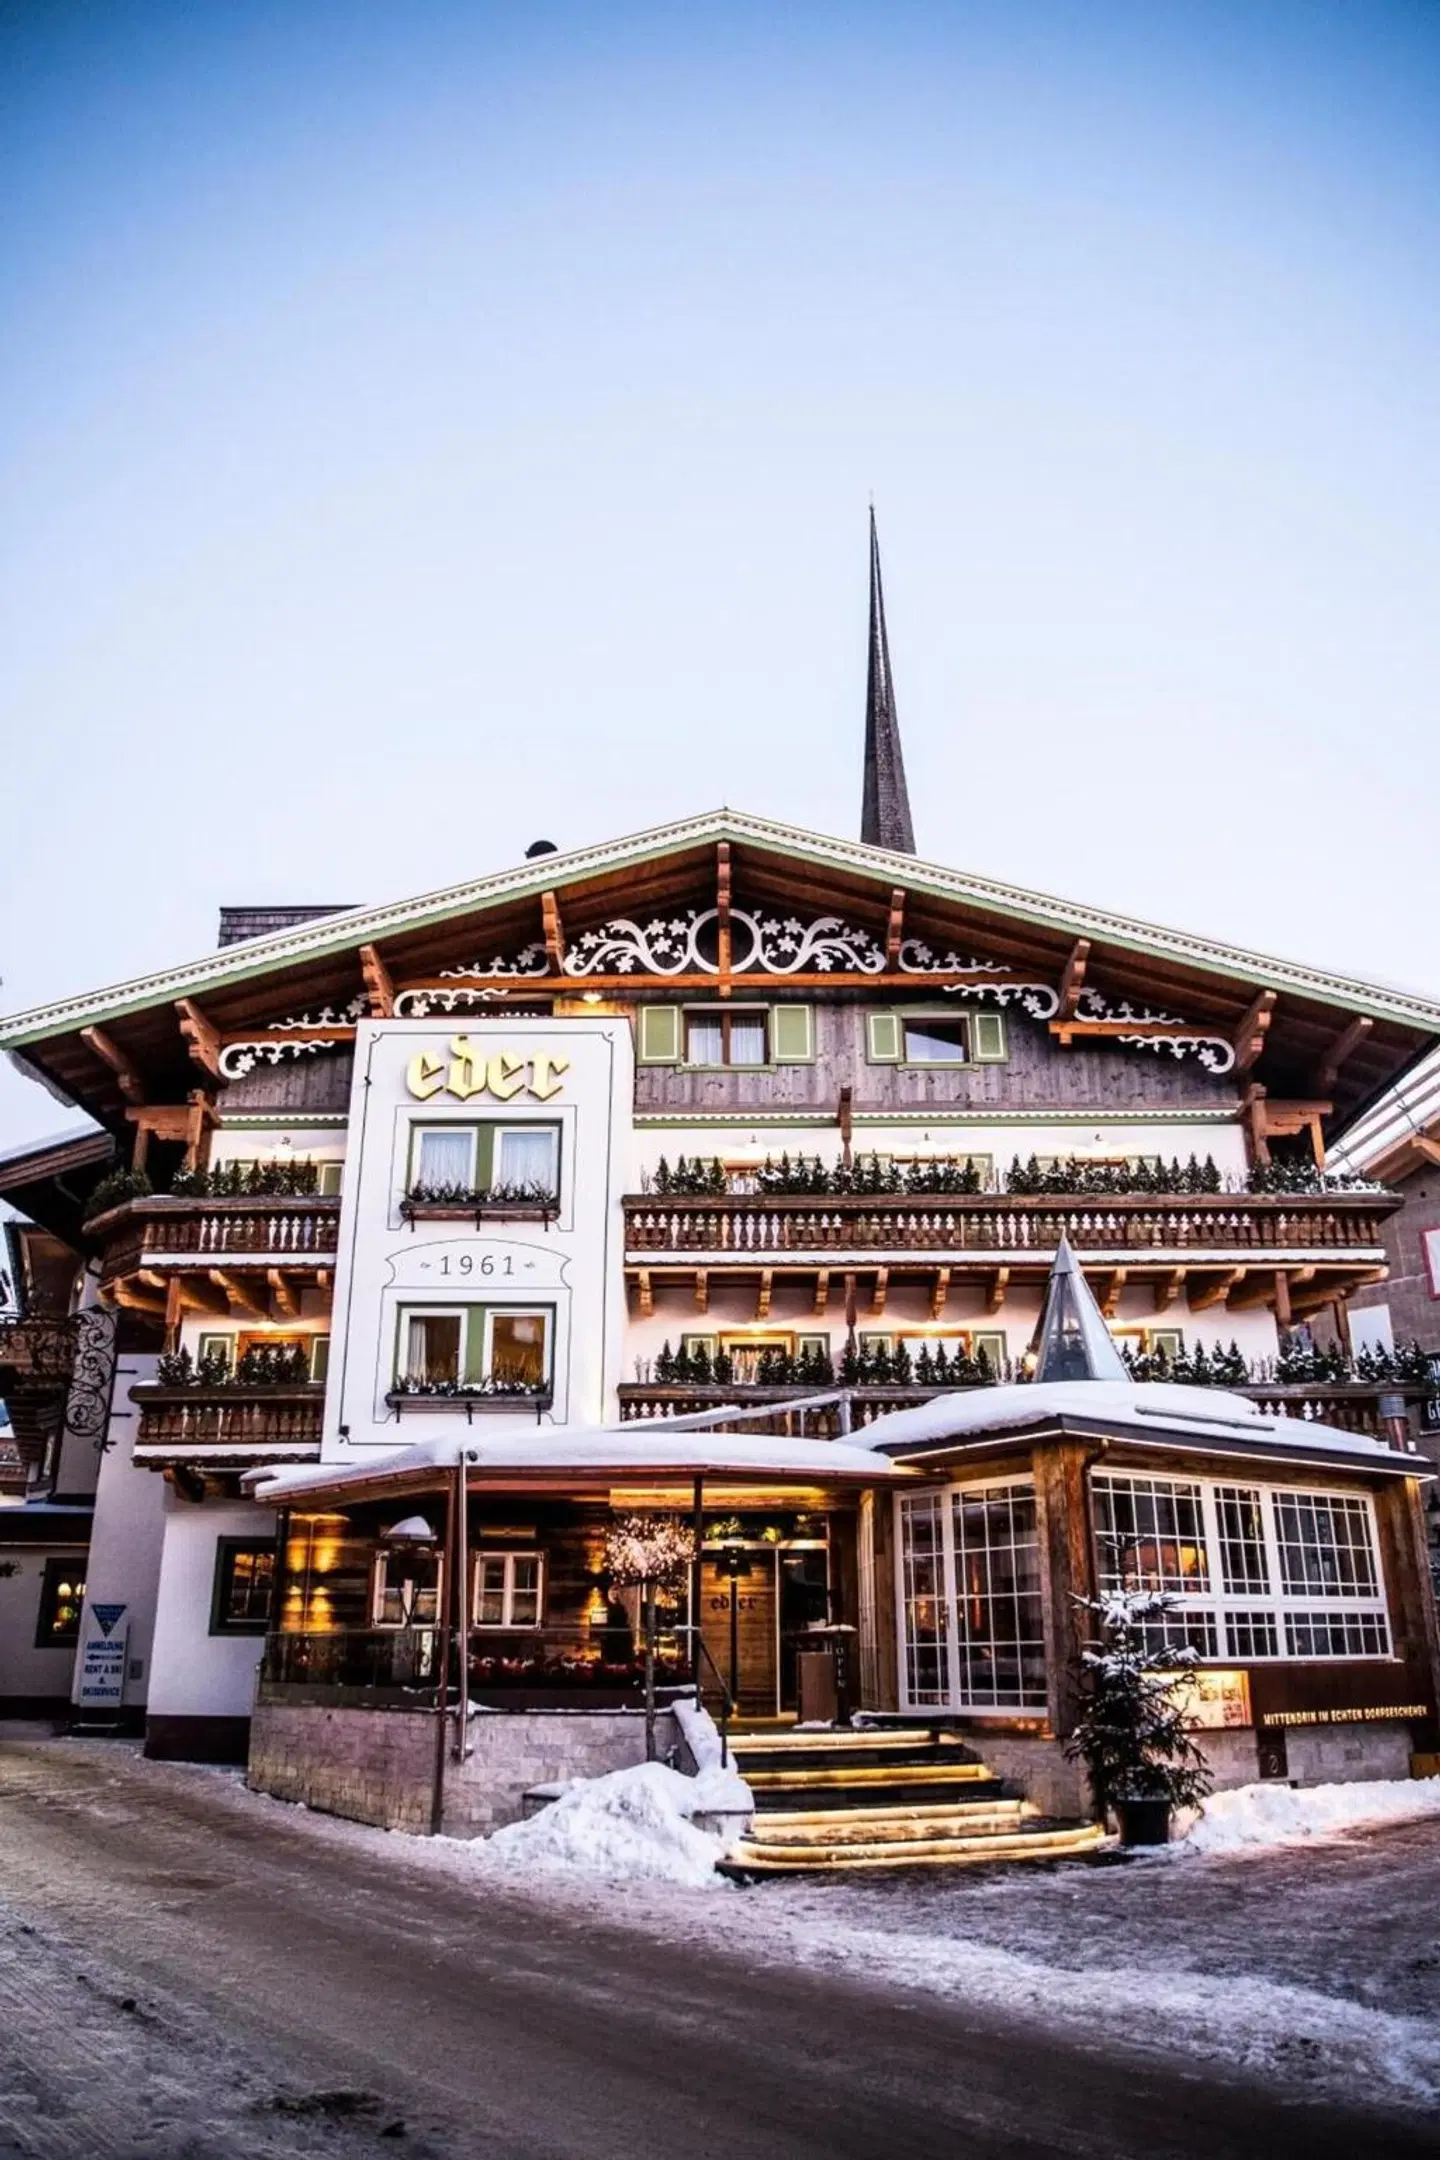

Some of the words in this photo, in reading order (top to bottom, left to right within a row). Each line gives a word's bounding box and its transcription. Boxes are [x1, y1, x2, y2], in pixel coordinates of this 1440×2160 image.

[406, 1034, 570, 1101] eder
[440, 1255, 514, 1275] 1961
[711, 1593, 757, 1610] eder
[85, 1665, 102, 1673] RENT
[104, 1664, 109, 1673] A
[111, 1665, 121, 1674] SKI
[835, 1646, 846, 1689] OPEN
[1263, 1712, 1317, 1726] MITTENDRIN
[1318, 1709, 1329, 1722] IM
[1330, 1708, 1363, 1722] ECHTEN
